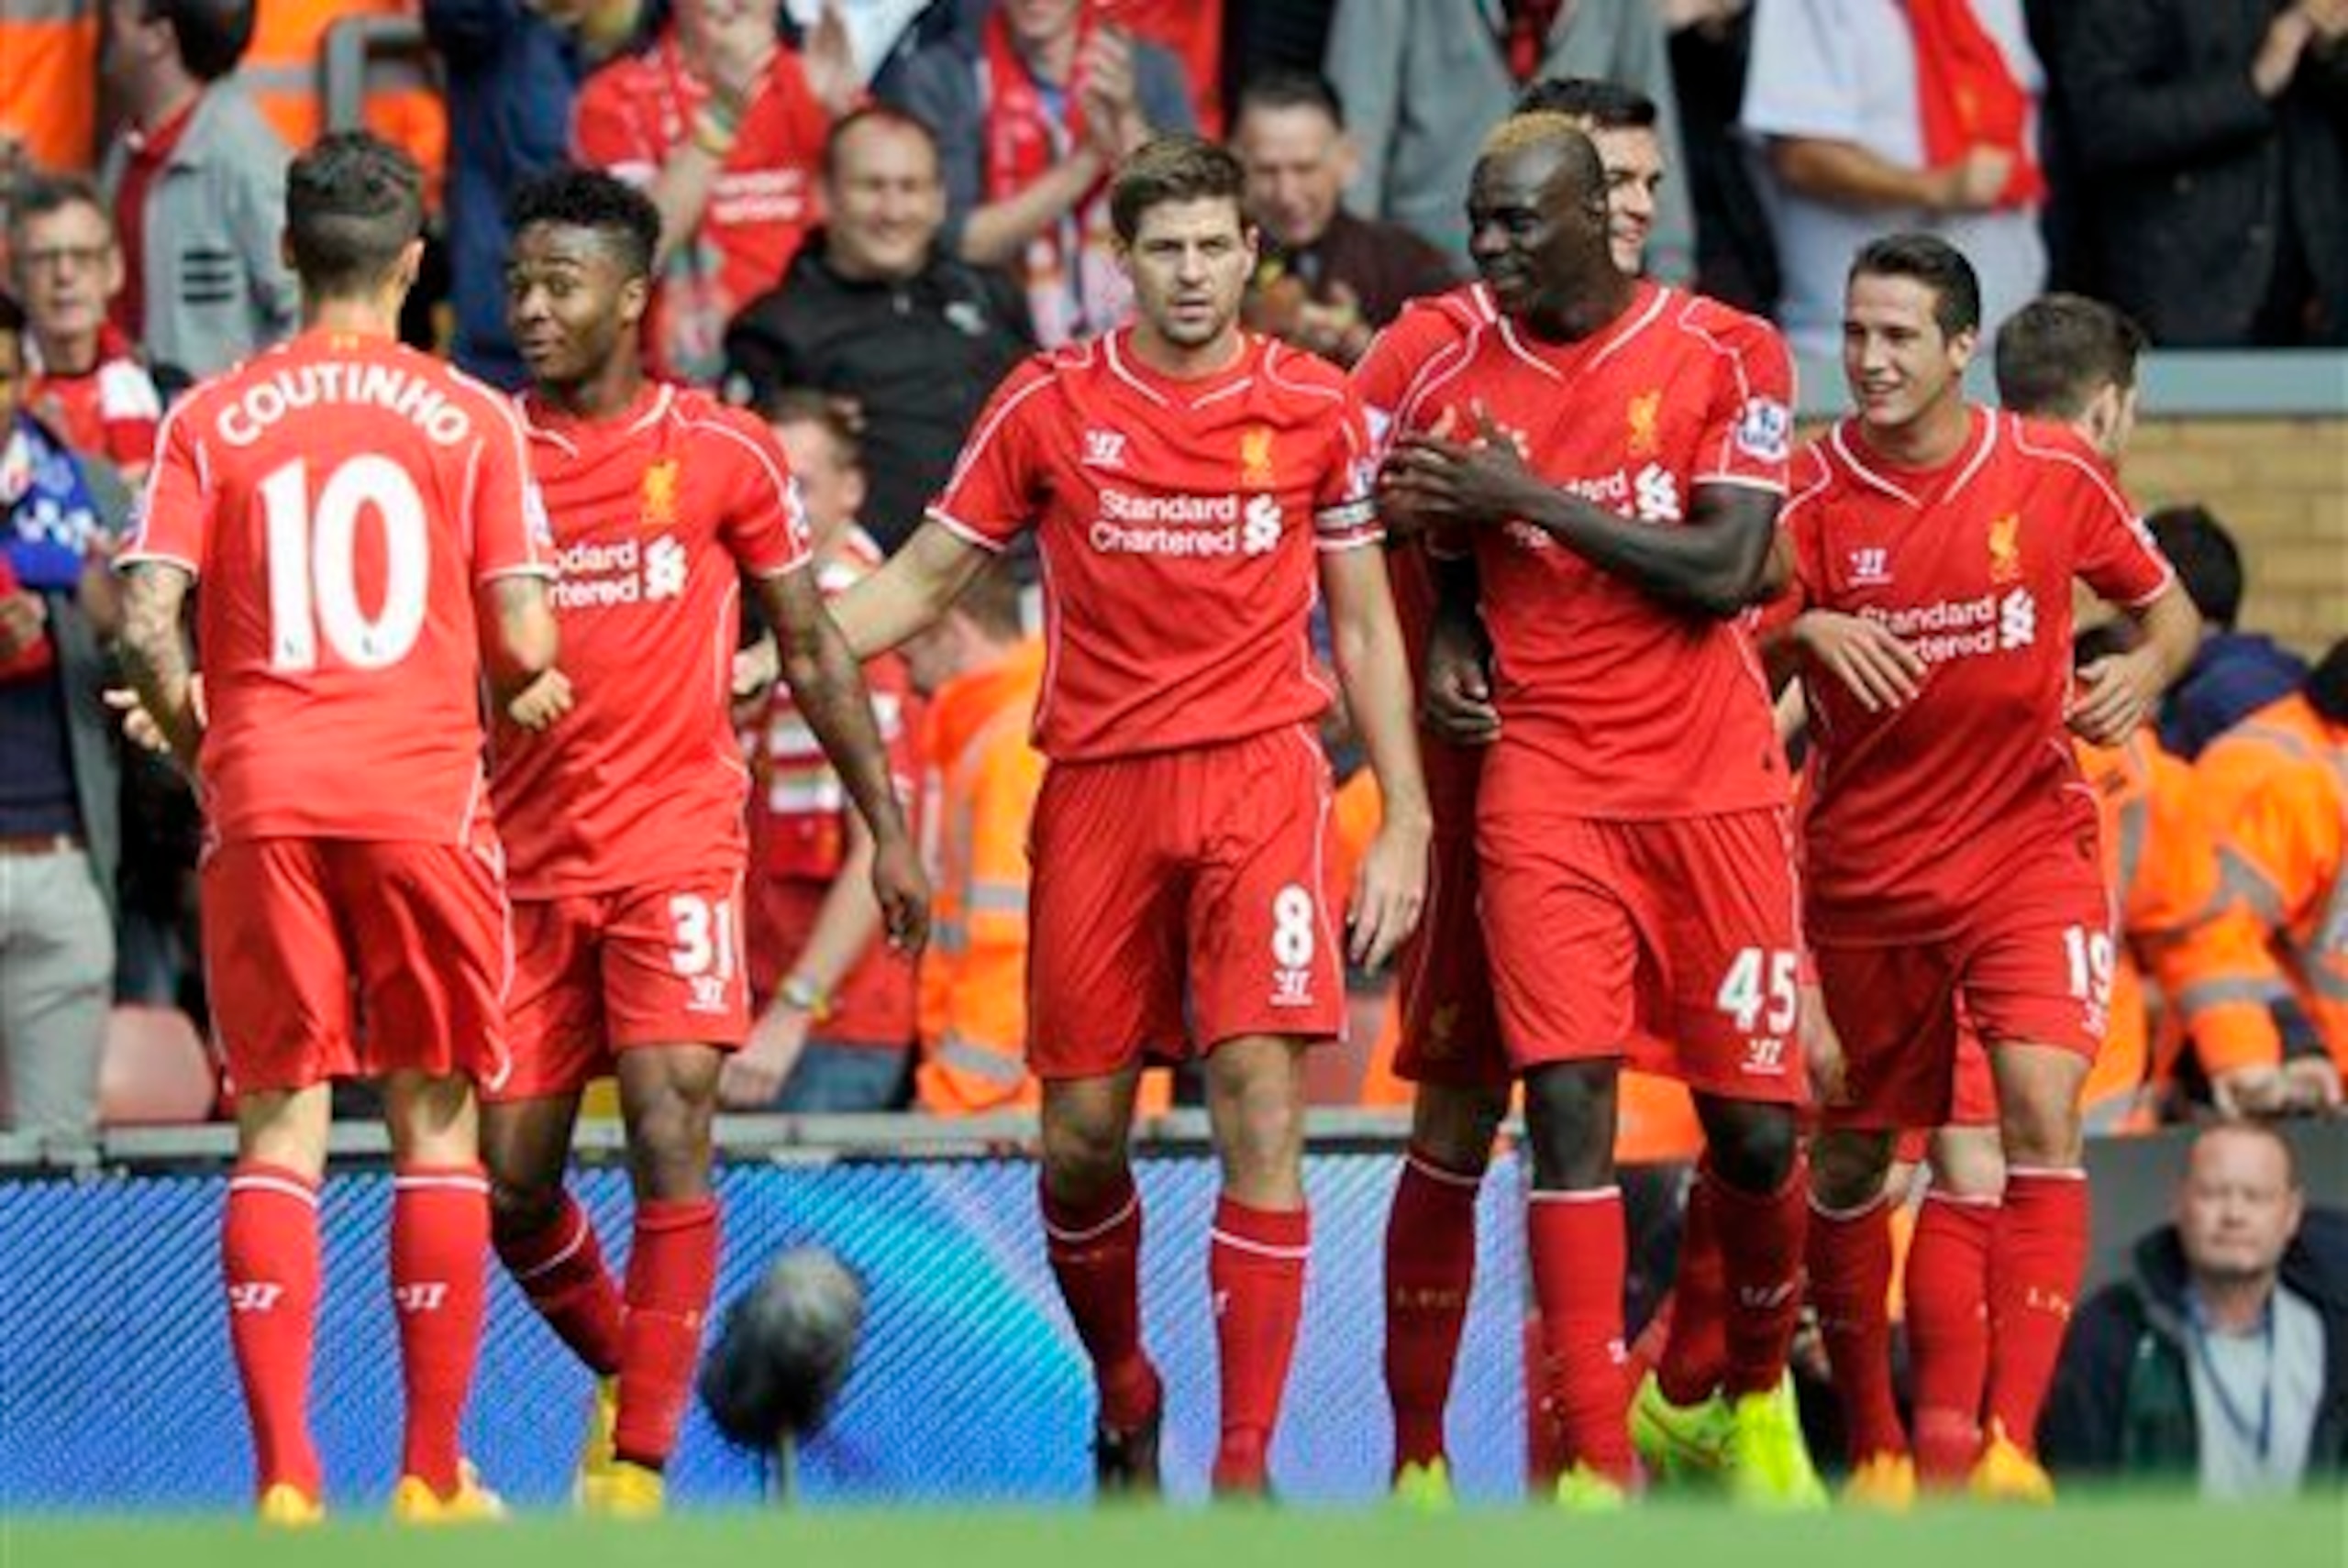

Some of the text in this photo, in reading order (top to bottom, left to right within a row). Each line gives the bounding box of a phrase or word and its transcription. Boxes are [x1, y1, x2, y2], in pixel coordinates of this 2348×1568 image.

[216, 360, 470, 447] COUTINHO
[1089, 520, 1236, 558] Chartered
[1099, 488, 1237, 523] Standard
[258, 453, 429, 674] 10
[668, 893, 733, 978] 31
[1272, 882, 1313, 969] 8
[2063, 923, 2115, 1006] 19
[1717, 945, 1797, 1033] 45
